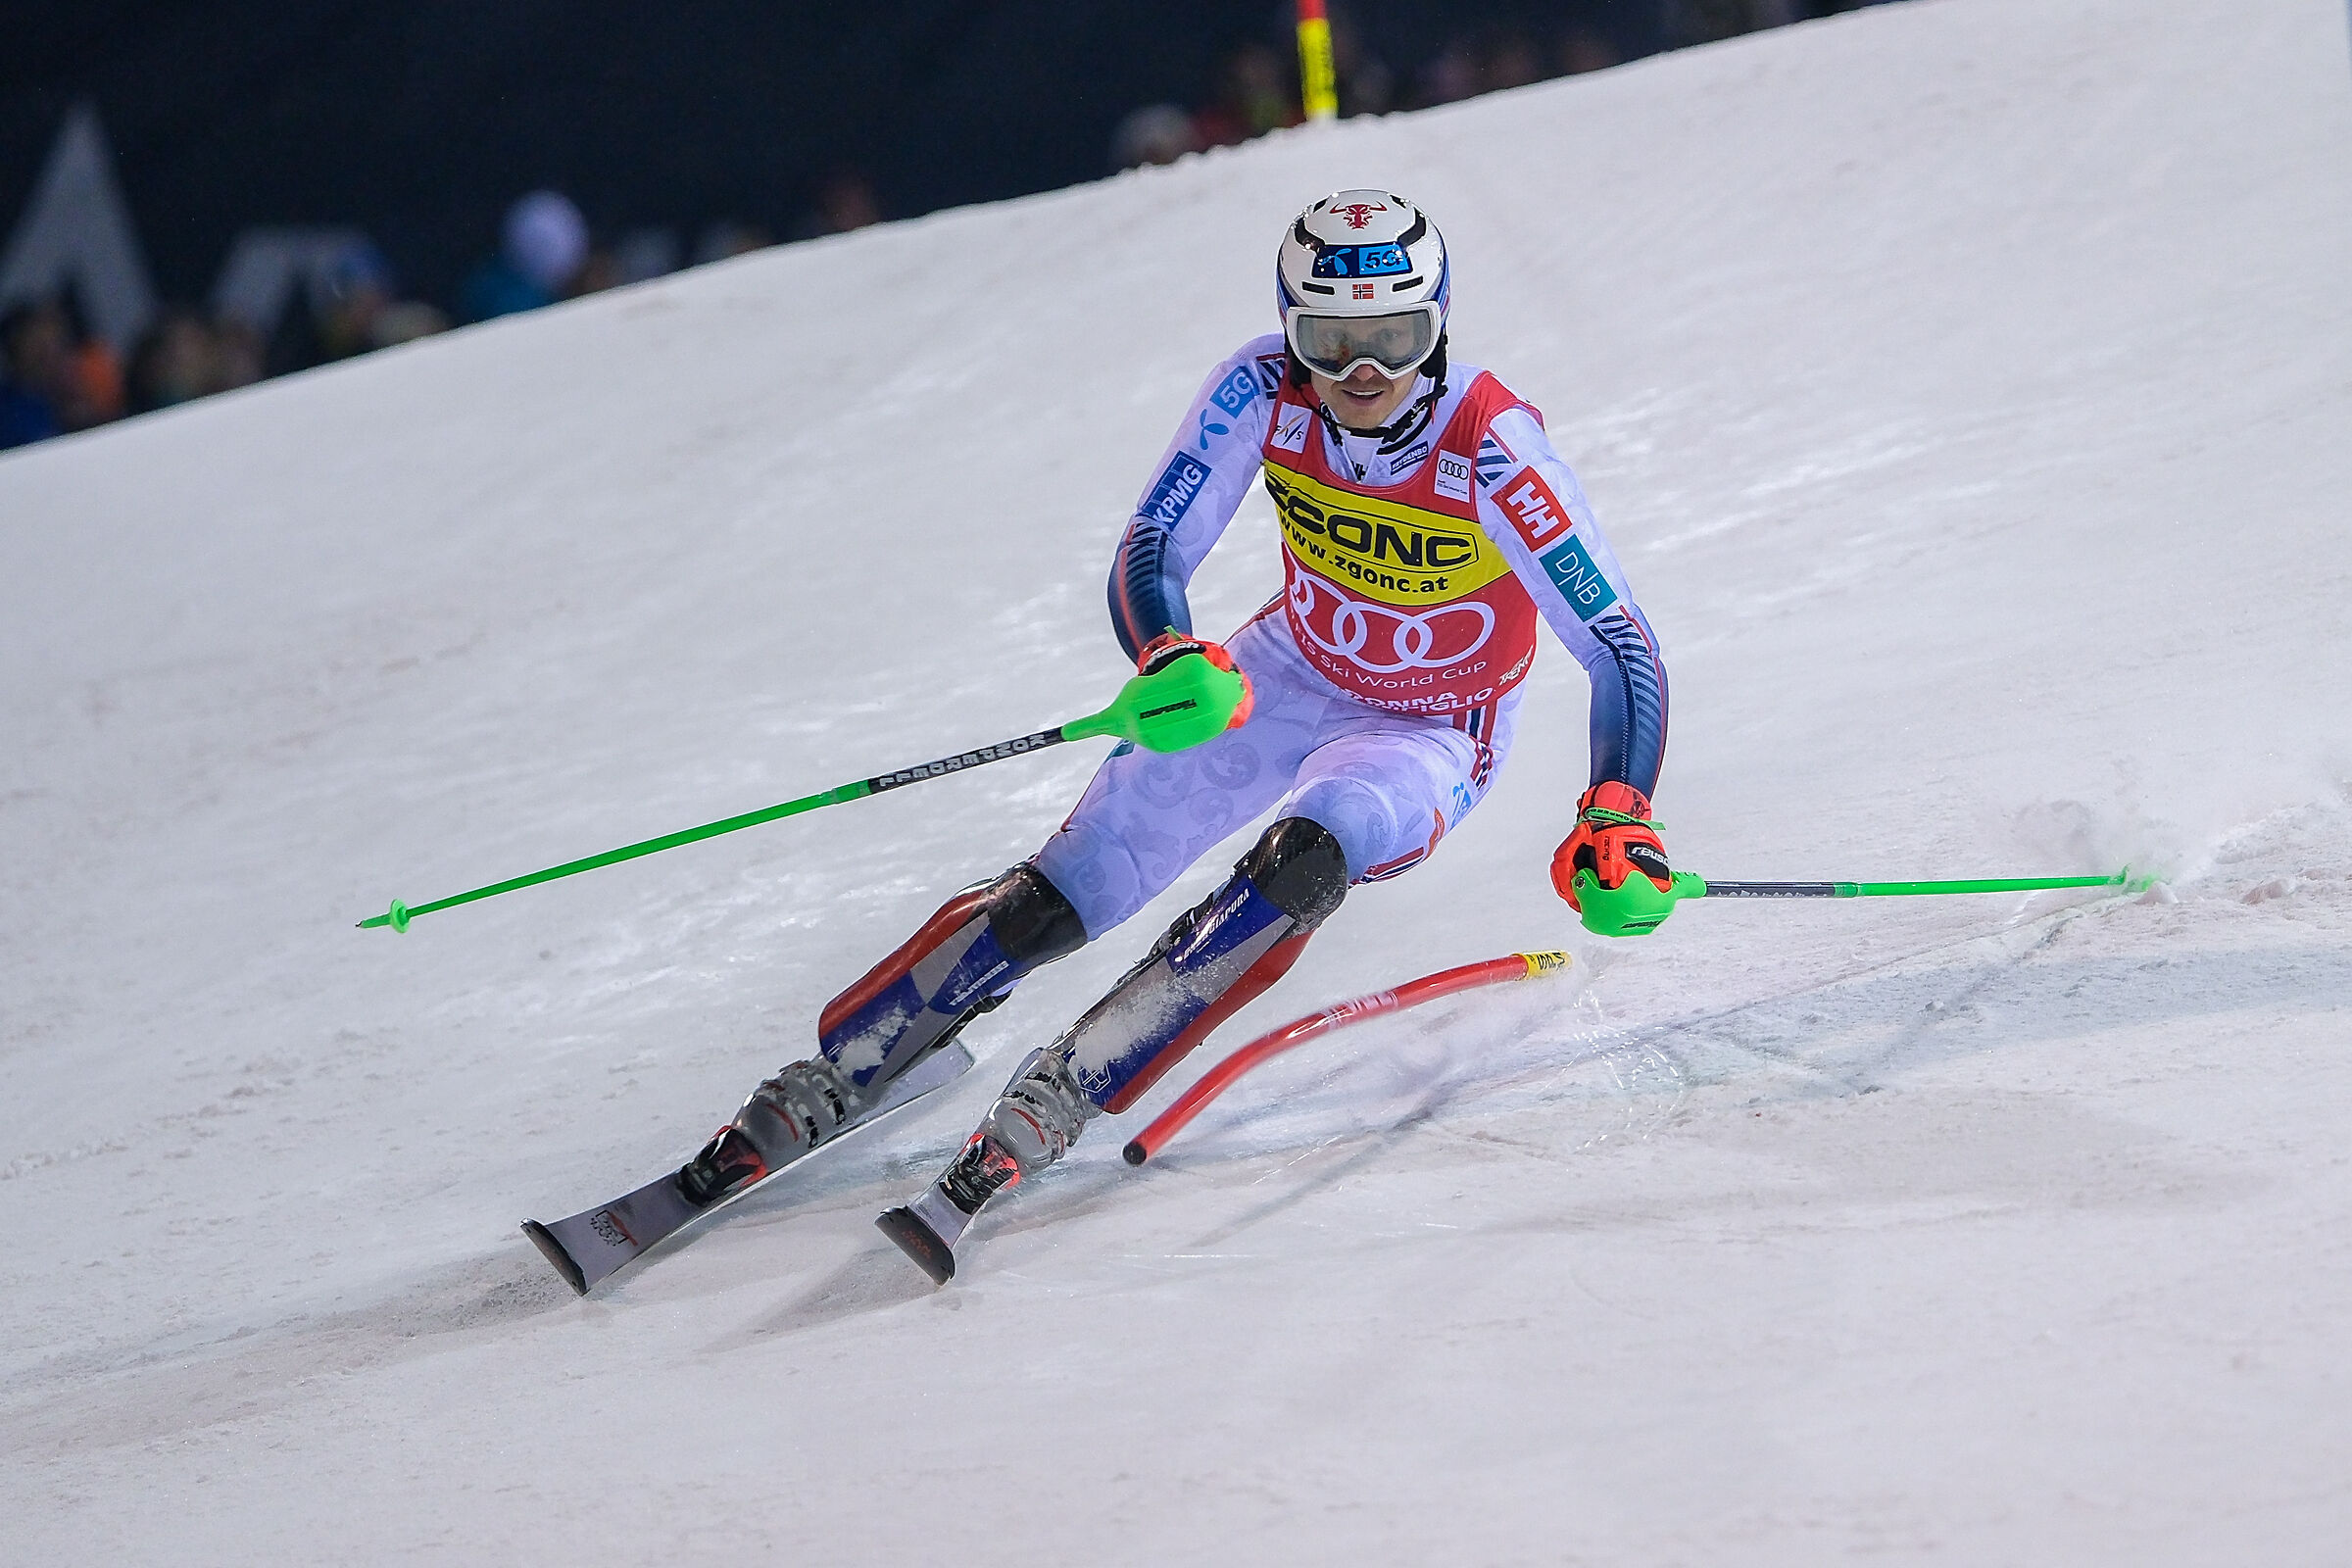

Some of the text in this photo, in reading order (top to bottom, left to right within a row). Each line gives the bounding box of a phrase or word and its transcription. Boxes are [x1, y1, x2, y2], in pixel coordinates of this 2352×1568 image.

[1364, 249, 1404, 270] 5G
[1218, 371, 1256, 409] 5G
[1152, 464, 1203, 526] KPMG
[1506, 480, 1560, 539] HH
[1279, 511, 1449, 594] www.zgonc.at
[1554, 551, 1601, 605] DNB
[1320, 655, 1349, 678] Ski
[1356, 671, 1434, 689] World
[1442, 660, 1488, 681] Cup
[879, 734, 1046, 787] KOMPERDELL
